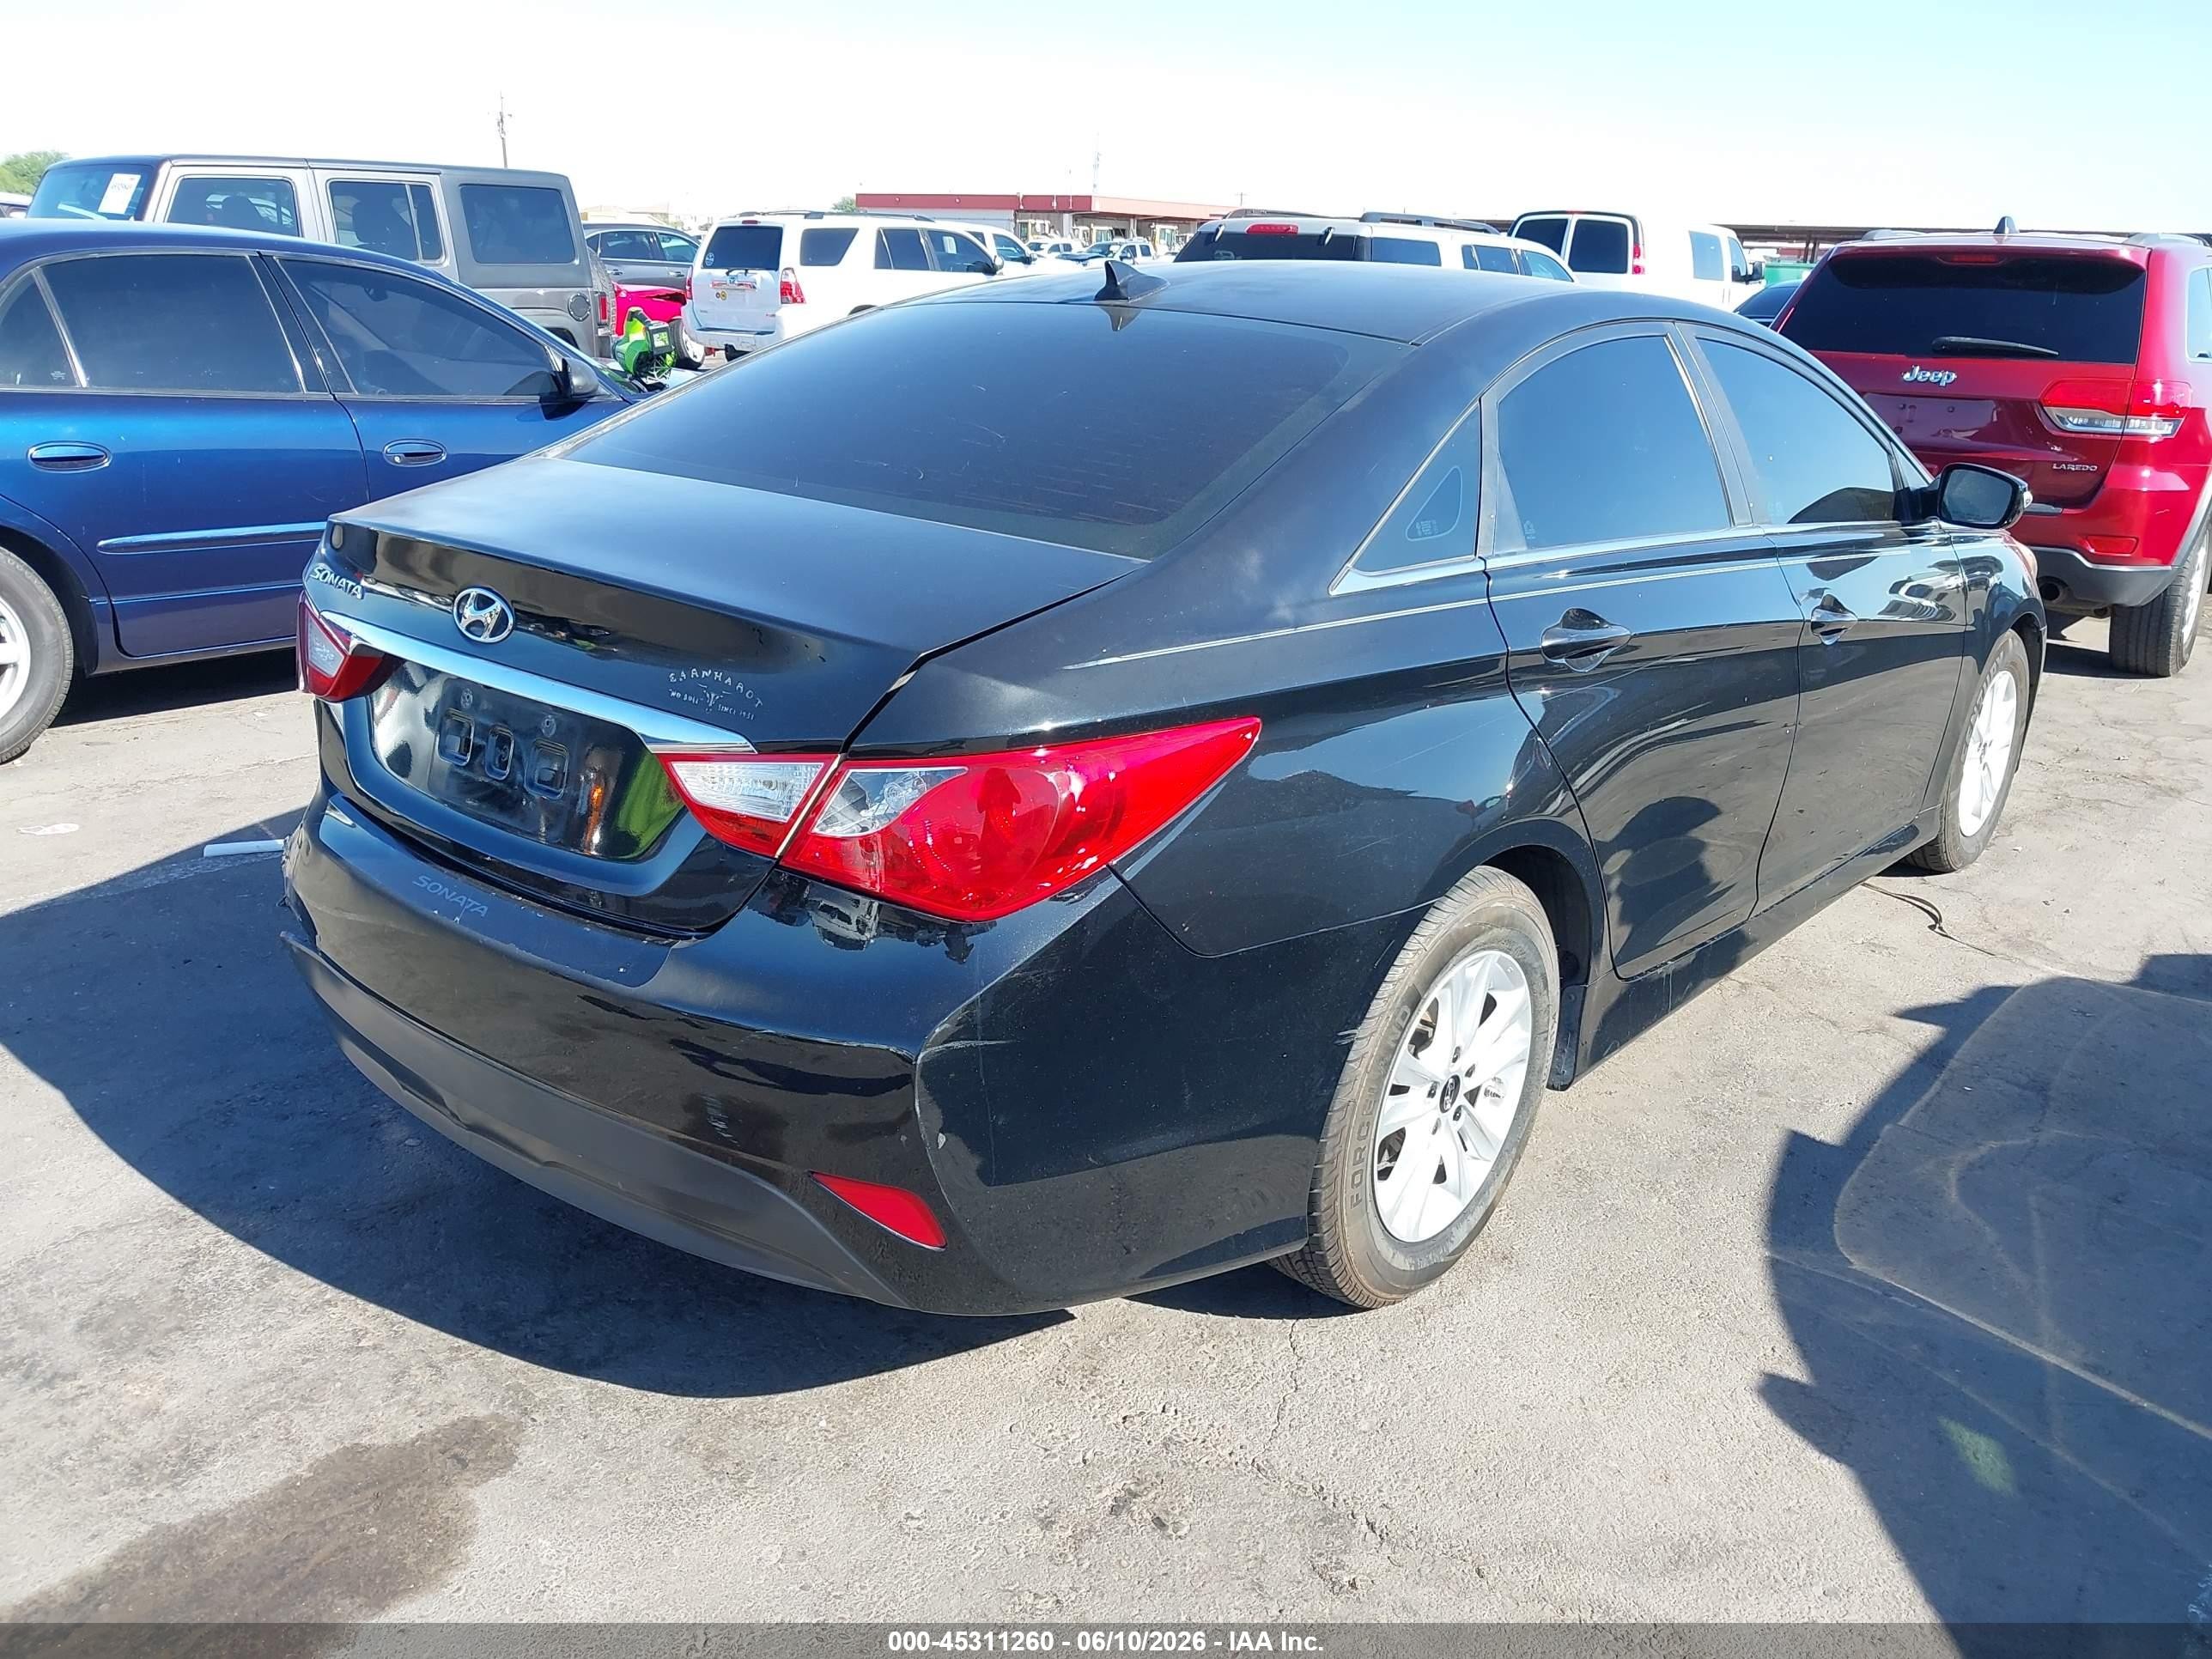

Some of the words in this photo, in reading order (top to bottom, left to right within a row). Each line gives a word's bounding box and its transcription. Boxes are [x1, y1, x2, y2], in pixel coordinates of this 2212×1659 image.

[1902, 364, 1957, 386] Jeep
[2052, 463, 2098, 471] LAREDO
[309, 566, 363, 599] SONATA
[669, 668, 763, 708] EARNHARDT
[412, 875, 489, 917] SONATA
